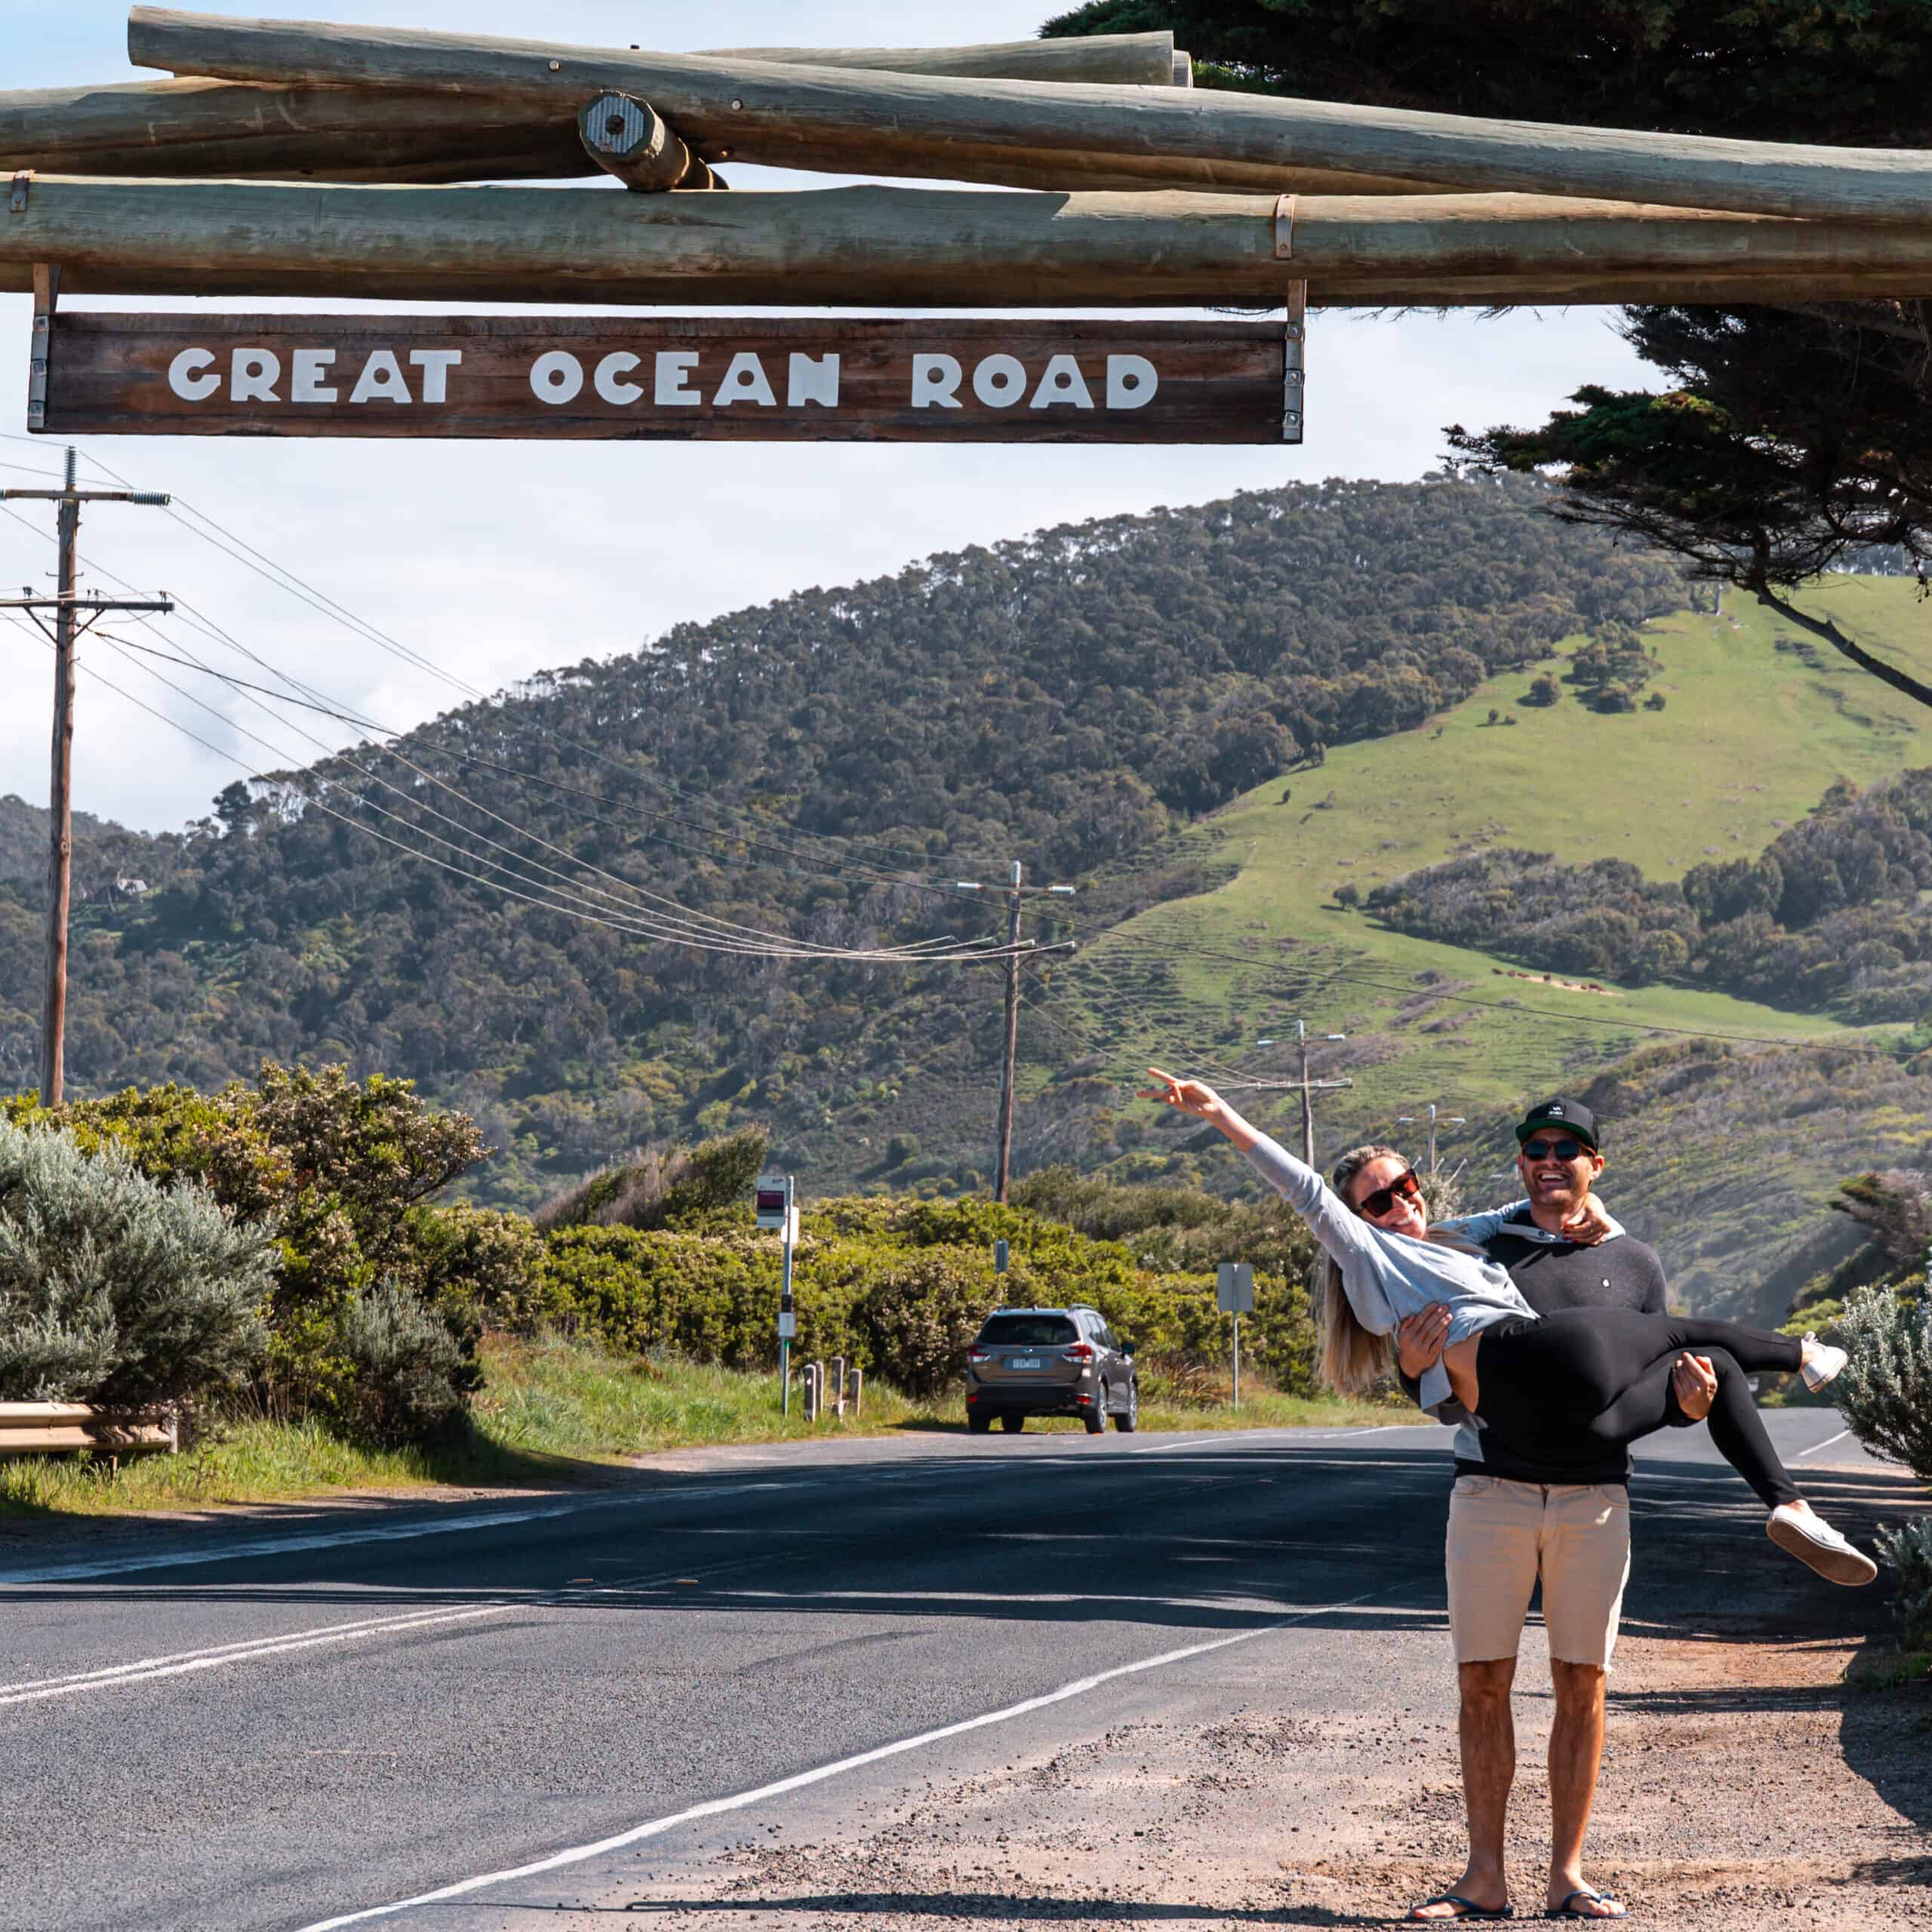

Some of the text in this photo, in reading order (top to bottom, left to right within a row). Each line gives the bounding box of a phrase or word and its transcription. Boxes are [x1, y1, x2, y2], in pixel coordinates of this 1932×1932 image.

[168, 348, 1158, 409] GREAT OCEAN ROAD
